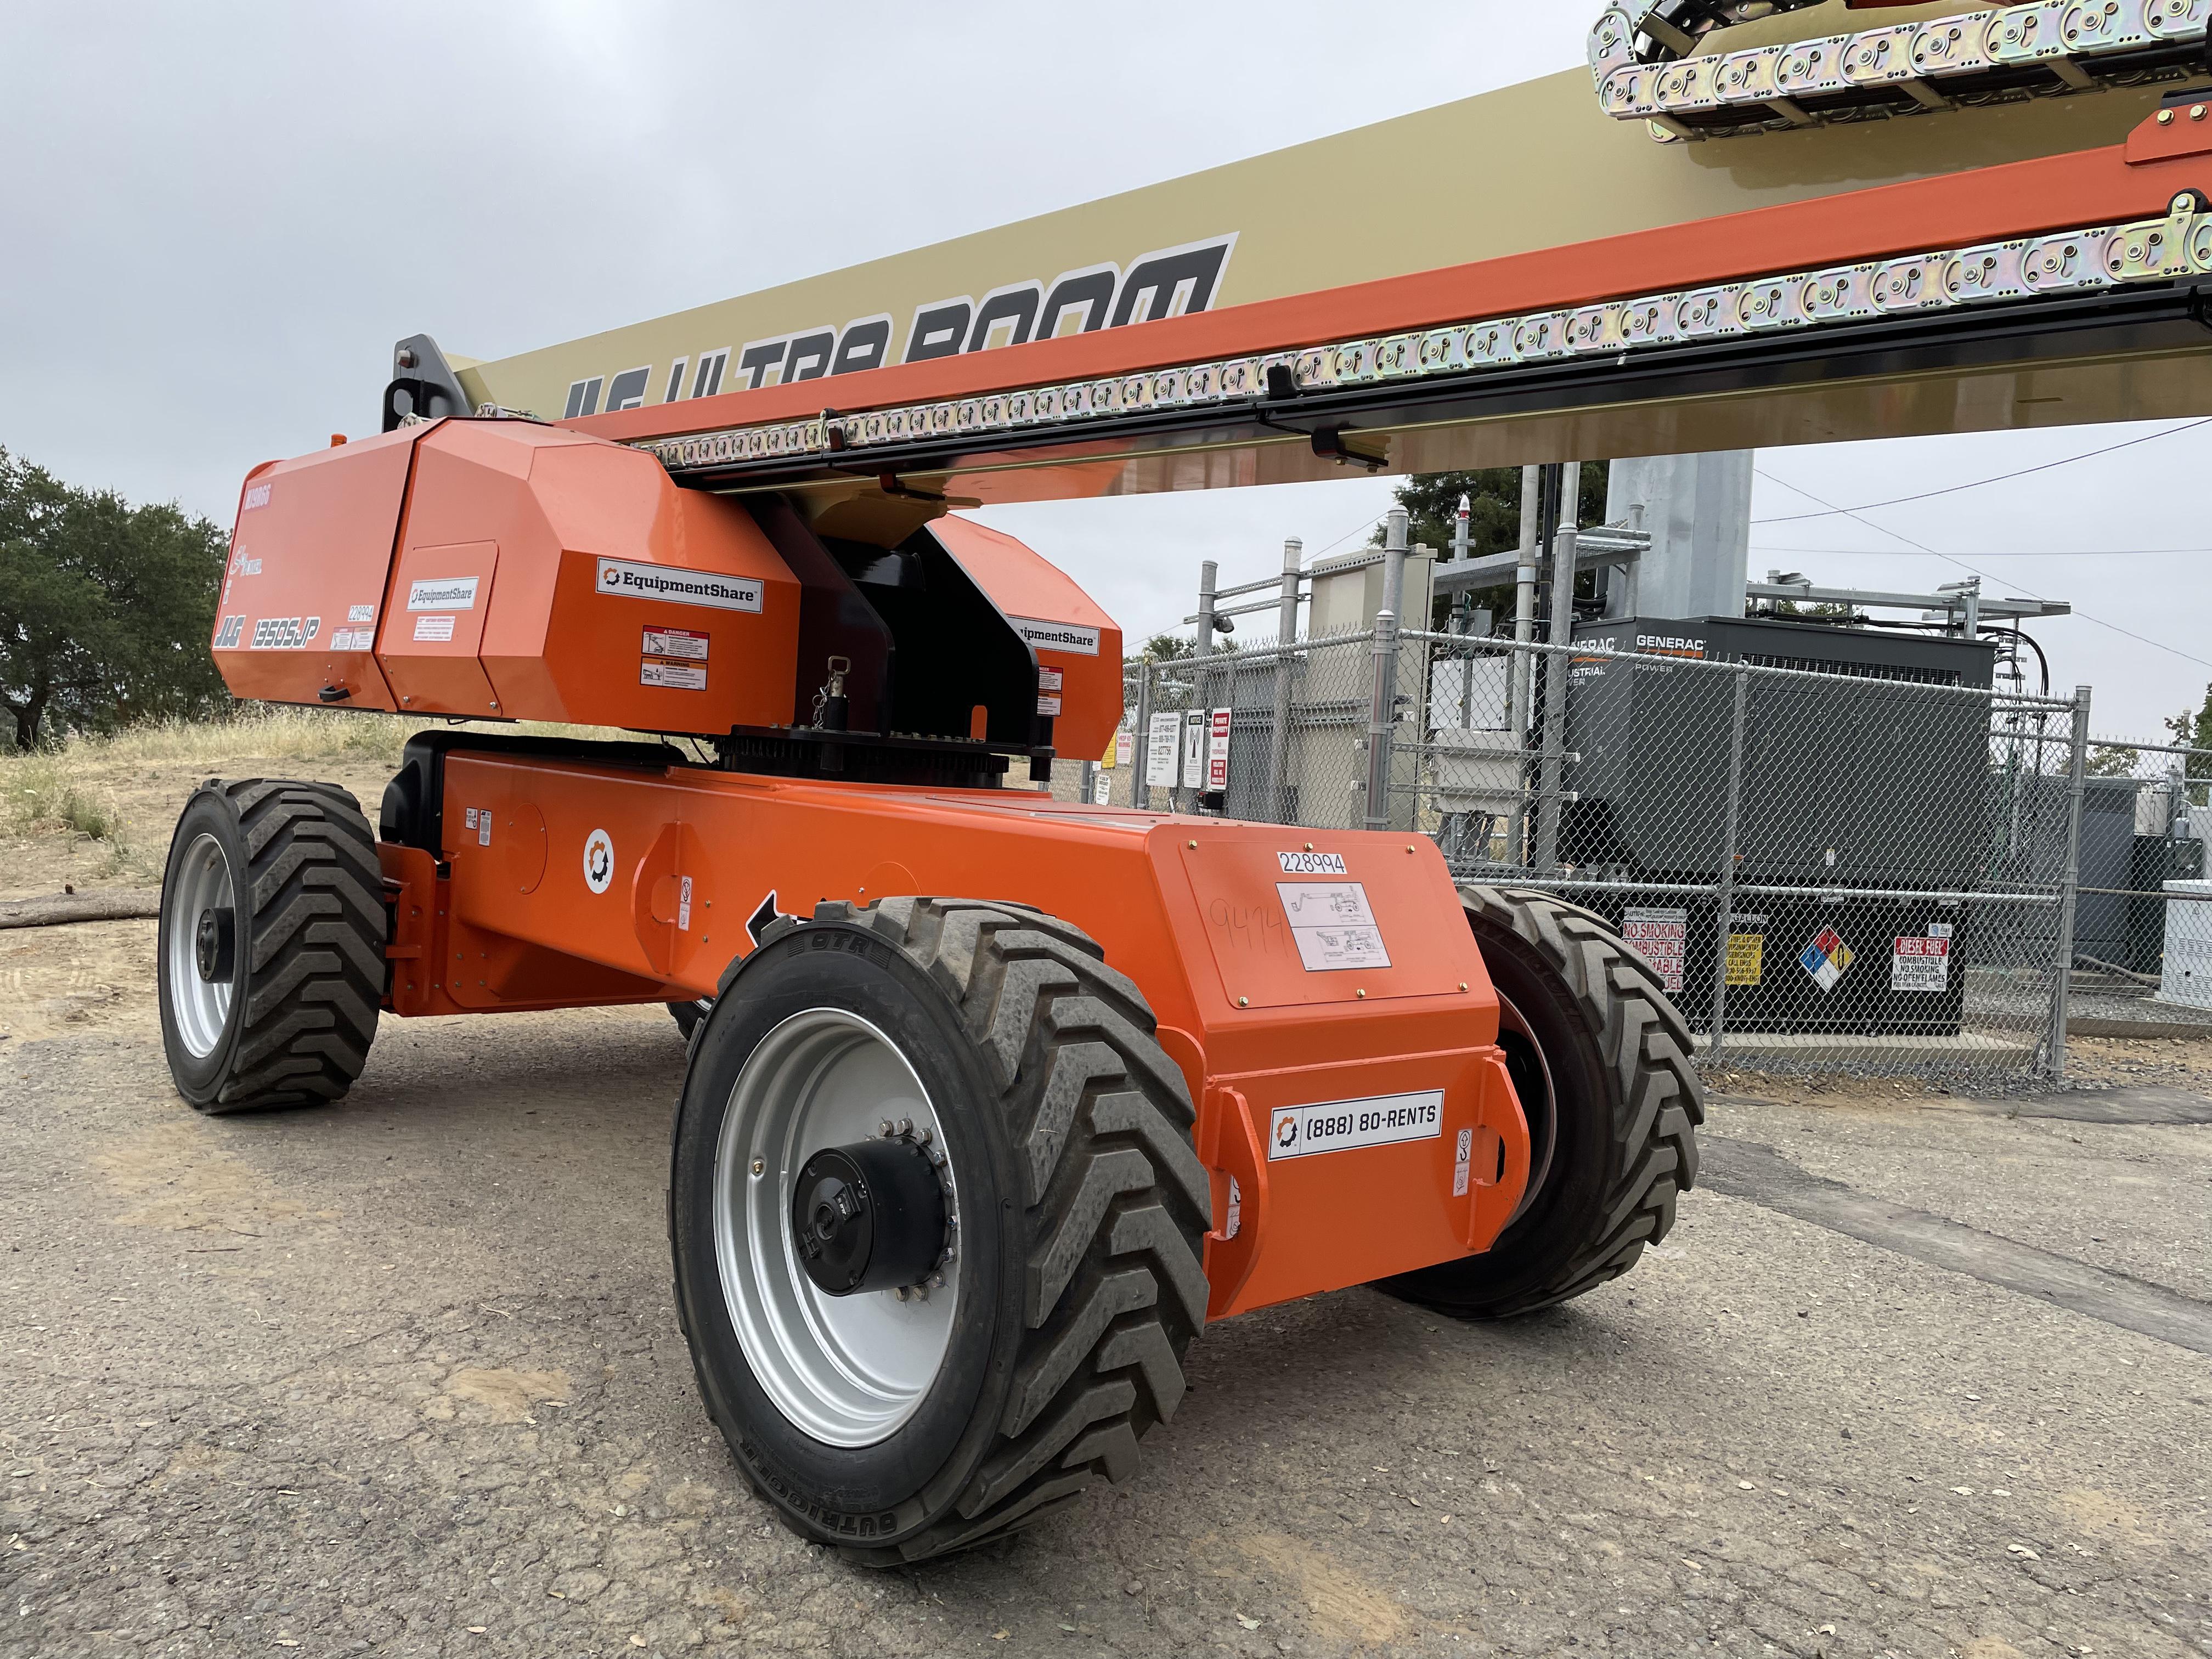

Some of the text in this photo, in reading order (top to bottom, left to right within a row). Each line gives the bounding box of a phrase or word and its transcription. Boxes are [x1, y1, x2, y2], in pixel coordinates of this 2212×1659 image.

[623, 572, 754, 601] EquipmentShare
[418, 588, 472, 603] EquipmentShare
[349, 606, 373, 620] 228994
[214, 615, 246, 648] JLG
[250, 617, 320, 649] 1350SJP
[1020, 627, 1093, 646] ipmentShare
[1637, 635, 1704, 651] GENERAC
[1568, 667, 1605, 678] USTRIAL
[1635, 664, 1673, 673] POWER
[1280, 853, 1345, 872] 228994
[1624, 923, 1684, 939] NO SMOKING
[812, 933, 869, 954] OTR
[1900, 939, 1943, 955] DIESEL FUEL
[1899, 956, 1942, 965] COMBUSTIBLE
[1921, 974, 1945, 983] FLAMES
[1307, 1105, 1436, 1141] (888) 80-RENTS
